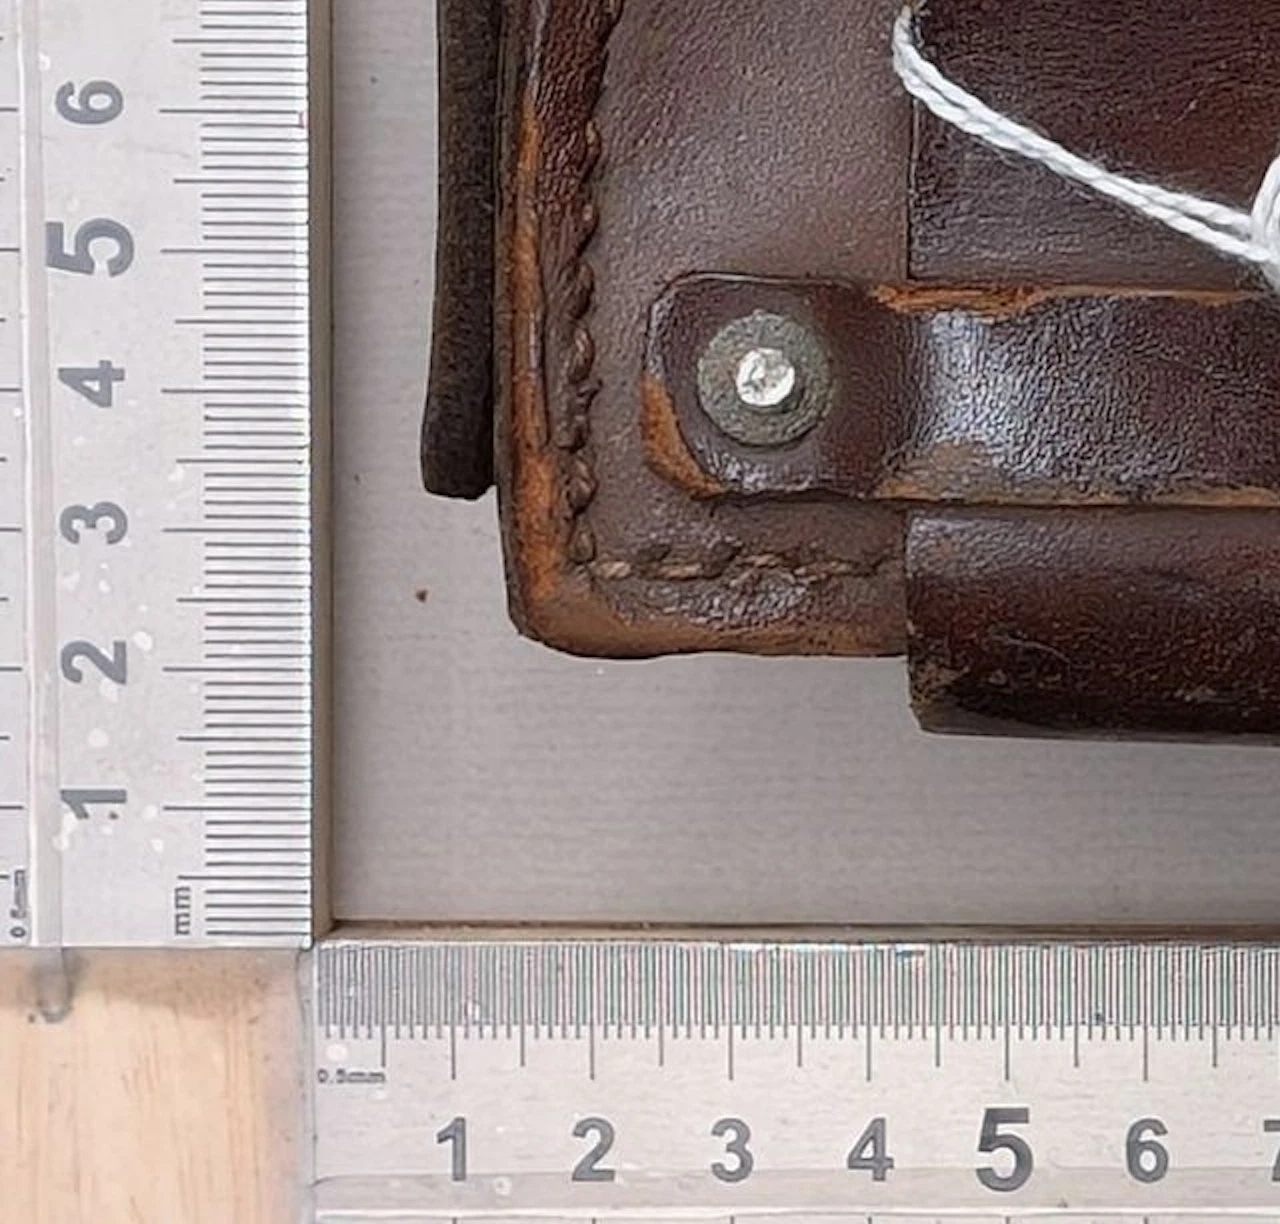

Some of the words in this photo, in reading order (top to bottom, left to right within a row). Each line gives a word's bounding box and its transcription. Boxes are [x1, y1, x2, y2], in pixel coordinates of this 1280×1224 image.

[55, 81, 123, 125] 6
[45, 219, 134, 277] 5
[58, 360, 125, 408] 4
[60, 502, 128, 545] 3
[61, 641, 127, 685] 2
[59, 789, 127, 820] 1
[175, 887, 190, 935] mm
[437, 1117, 467, 1182] 1
[571, 1118, 616, 1182] 2
[711, 1118, 753, 1183] 3
[847, 1118, 894, 1182] 4
[976, 1108, 1033, 1192] 5
[1126, 1119, 1169, 1184] 6
